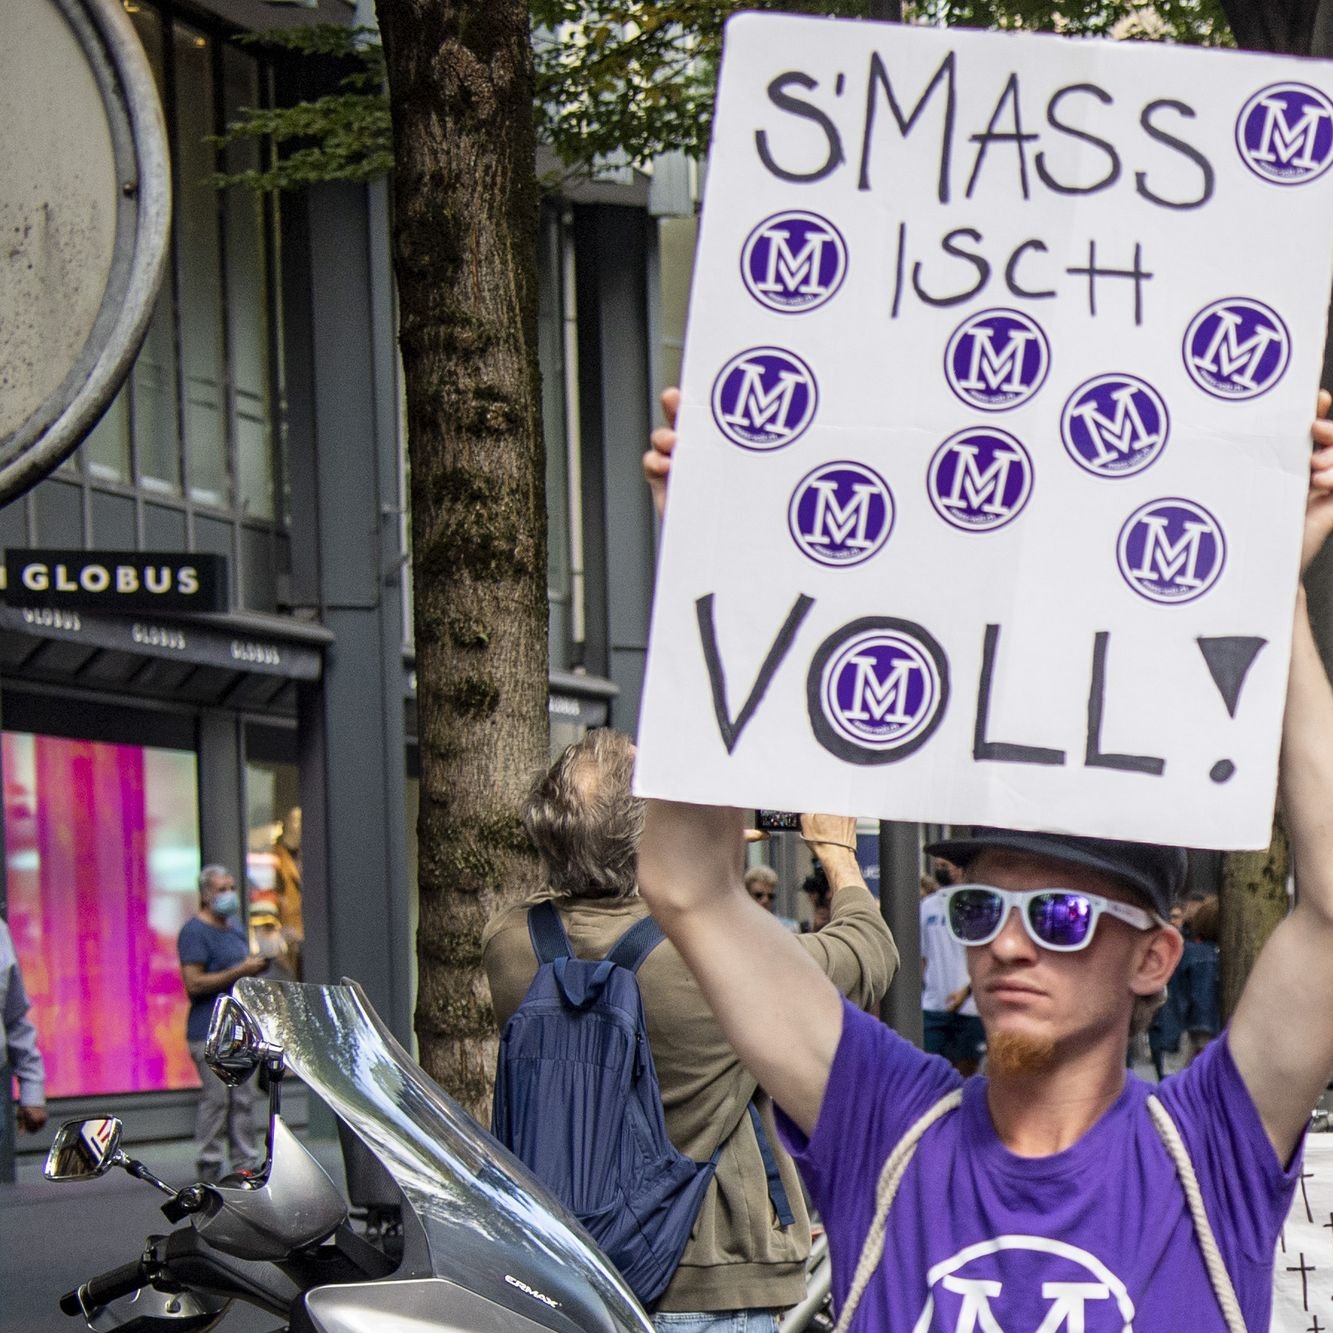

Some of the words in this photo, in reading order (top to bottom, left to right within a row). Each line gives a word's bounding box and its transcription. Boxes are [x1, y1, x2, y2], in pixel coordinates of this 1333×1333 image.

[756, 50, 1215, 210] S'MASS
[889, 221, 1154, 326] ISCH
[22, 563, 199, 594] GLOBUS
